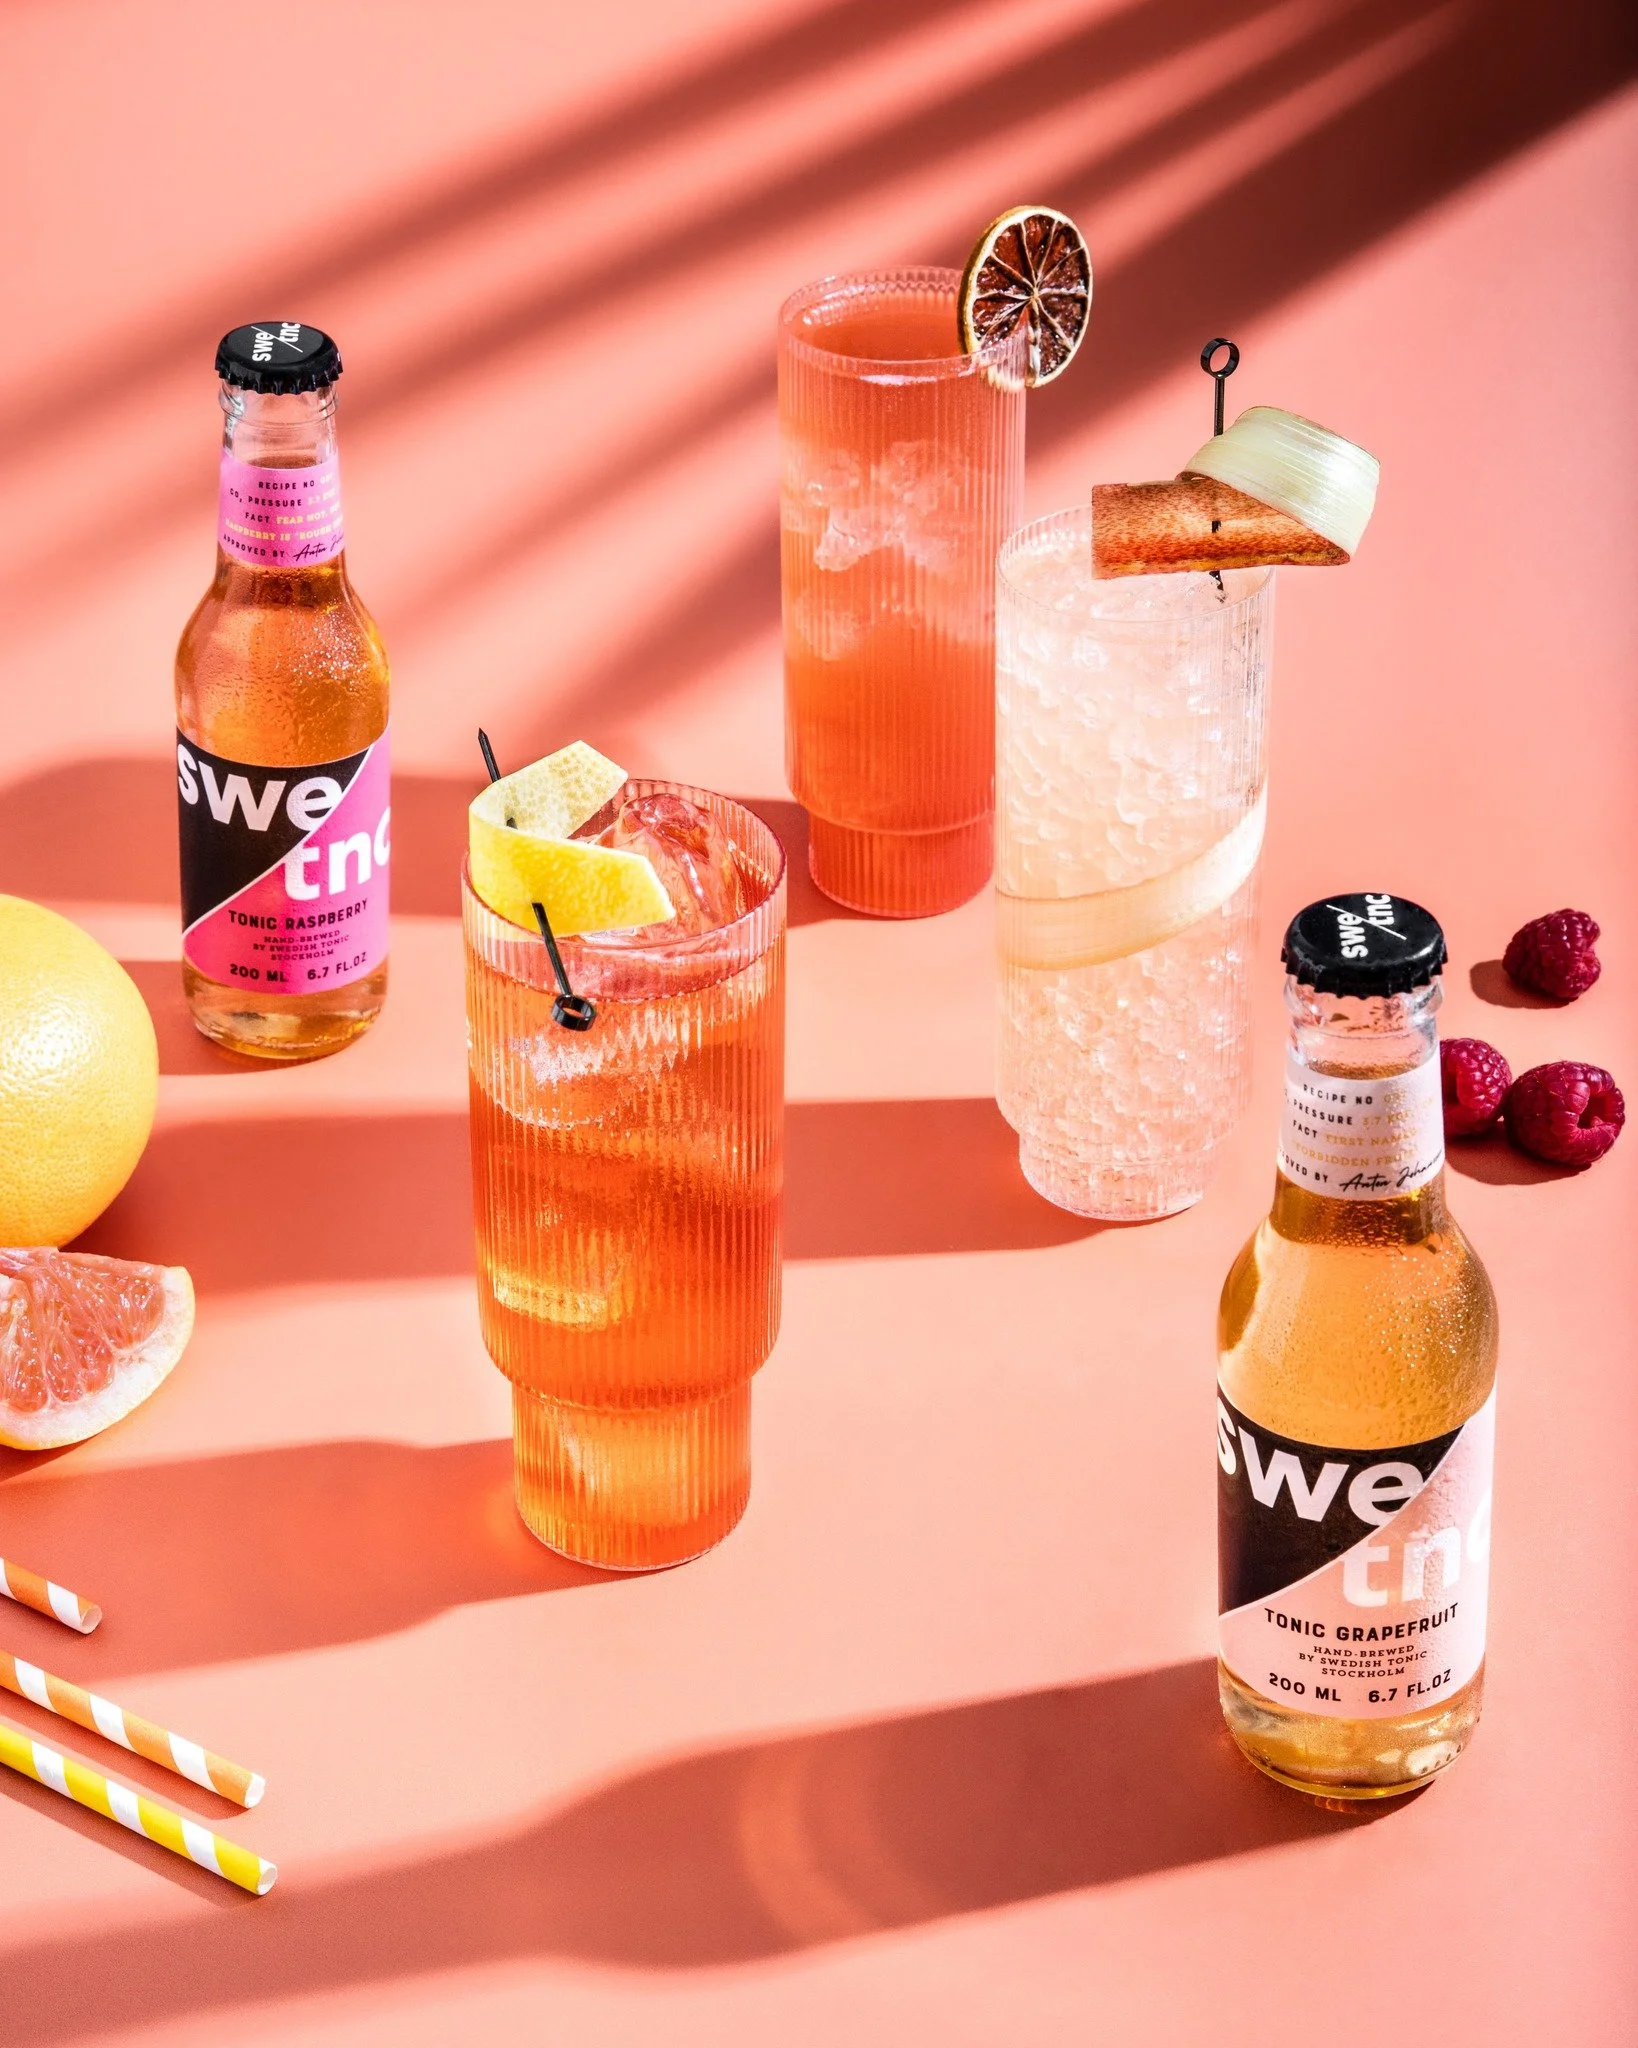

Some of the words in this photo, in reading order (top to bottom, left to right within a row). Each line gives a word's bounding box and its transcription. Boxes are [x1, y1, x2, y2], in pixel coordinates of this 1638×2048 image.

[279, 322, 301, 342] tnc
[252, 332, 275, 361] swe
[258, 481, 297, 490] RECIPE
[303, 480, 315, 489] NO
[249, 496, 302, 507] PRESSURE
[245, 512, 270, 523] FACT
[276, 516, 303, 525] FEAR
[223, 534, 266, 556] APPROVED
[280, 533, 291, 542] IS
[177, 743, 344, 832] swe
[228, 910, 277, 930] TONIC
[285, 898, 368, 930] RASPBERRY
[1365, 894, 1395, 926] tnc
[253, 943, 265, 951] BY
[270, 943, 317, 952] SWEDISH
[321, 935, 350, 948] TONIC
[264, 930, 340, 944] HAND-BREWED
[1337, 913, 1369, 959] swe
[271, 949, 334, 961] STOCKHOLM
[307, 966, 329, 980] 6.7
[336, 951, 367, 975] FL.OZ
[230, 963, 260, 980] 200
[266, 970, 288, 982] ML
[1303, 1084, 1347, 1104] RECIPE
[1356, 1096, 1373, 1105] NO
[1294, 1099, 1353, 1125] PRESSURE
[1293, 1120, 1318, 1138] FACT
[1325, 1134, 1365, 1146] FIRST
[1293, 1140, 1370, 1167] FORBIDDEN
[1315, 1172, 1328, 1183] BY
[1217, 1396, 1424, 1527] swe
[1264, 1607, 1326, 1638] TONIC
[1336, 1602, 1459, 1642] GRAPEFRUIT
[1299, 1653, 1314, 1662] BY
[1320, 1657, 1382, 1668] SWEDISH
[1388, 1651, 1428, 1666] TONIC
[1313, 1645, 1415, 1658] HAND-BREWED
[1321, 1667, 1406, 1678] STOCKHOLM
[1269, 1672, 1306, 1695] 200
[1315, 1686, 1342, 1702] ML
[1368, 1688, 1398, 1703] 6.7
[1407, 1669, 1452, 1698] FL.OZ
